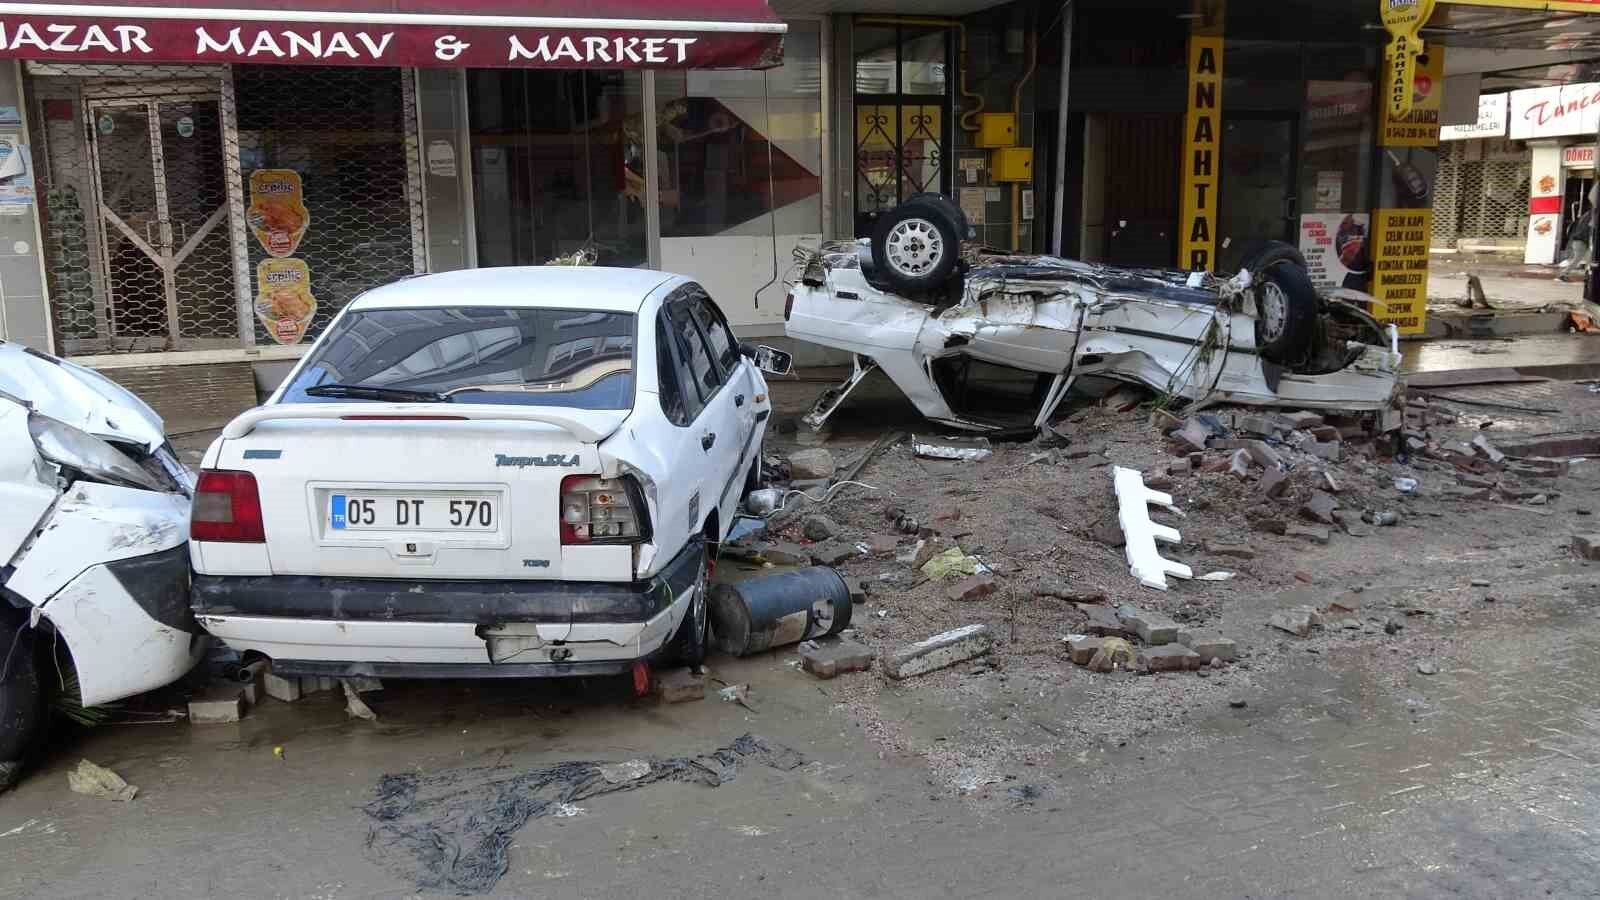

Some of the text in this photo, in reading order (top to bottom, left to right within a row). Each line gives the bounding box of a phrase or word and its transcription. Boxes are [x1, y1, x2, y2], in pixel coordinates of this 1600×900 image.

[195, 26, 395, 60] MANAV
[434, 33, 471, 61] &
[508, 34, 698, 64] MARKET
[1393, 35, 1407, 110] ANAHTARCI
[348, 499, 492, 527] 05 DT 570
